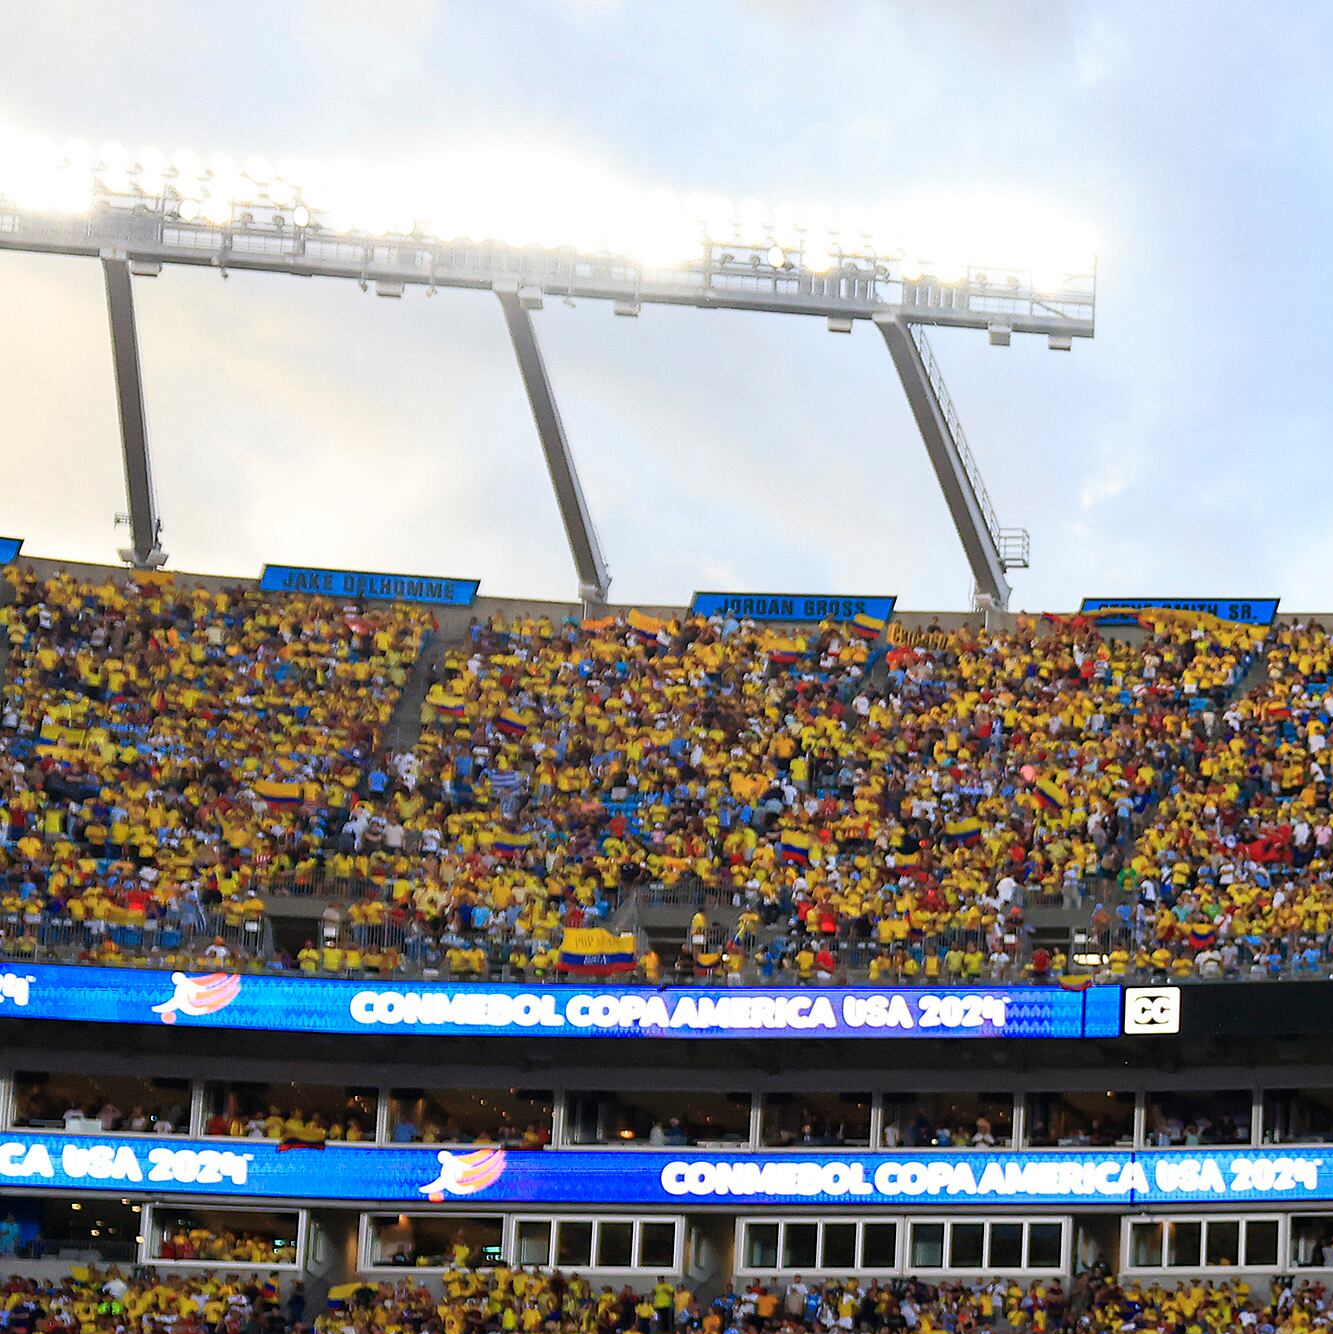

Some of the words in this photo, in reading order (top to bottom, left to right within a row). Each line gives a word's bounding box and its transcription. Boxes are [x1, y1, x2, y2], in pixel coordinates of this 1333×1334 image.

[283, 571, 333, 593] JAKE
[343, 575, 455, 602] DELHOMME
[718, 598, 794, 616] JORDAN
[803, 600, 866, 617] GROSS
[1228, 604, 1258, 620] SR.
[349, 990, 564, 1027] CONMEBOL
[565, 995, 671, 1028] COPA
[669, 994, 837, 1028] AMERICA
[842, 995, 915, 1029] USA
[918, 992, 1007, 1027] 2024
[1132, 995, 1172, 1025] CC
[61, 1144, 143, 1181] USA
[147, 1147, 249, 1185] 2024
[659, 1160, 874, 1197] CONMEBOL
[874, 1160, 981, 1195] COPA
[981, 1160, 1150, 1196] AMERICA
[1155, 1160, 1226, 1195] USA
[1229, 1157, 1318, 1192] 2024
